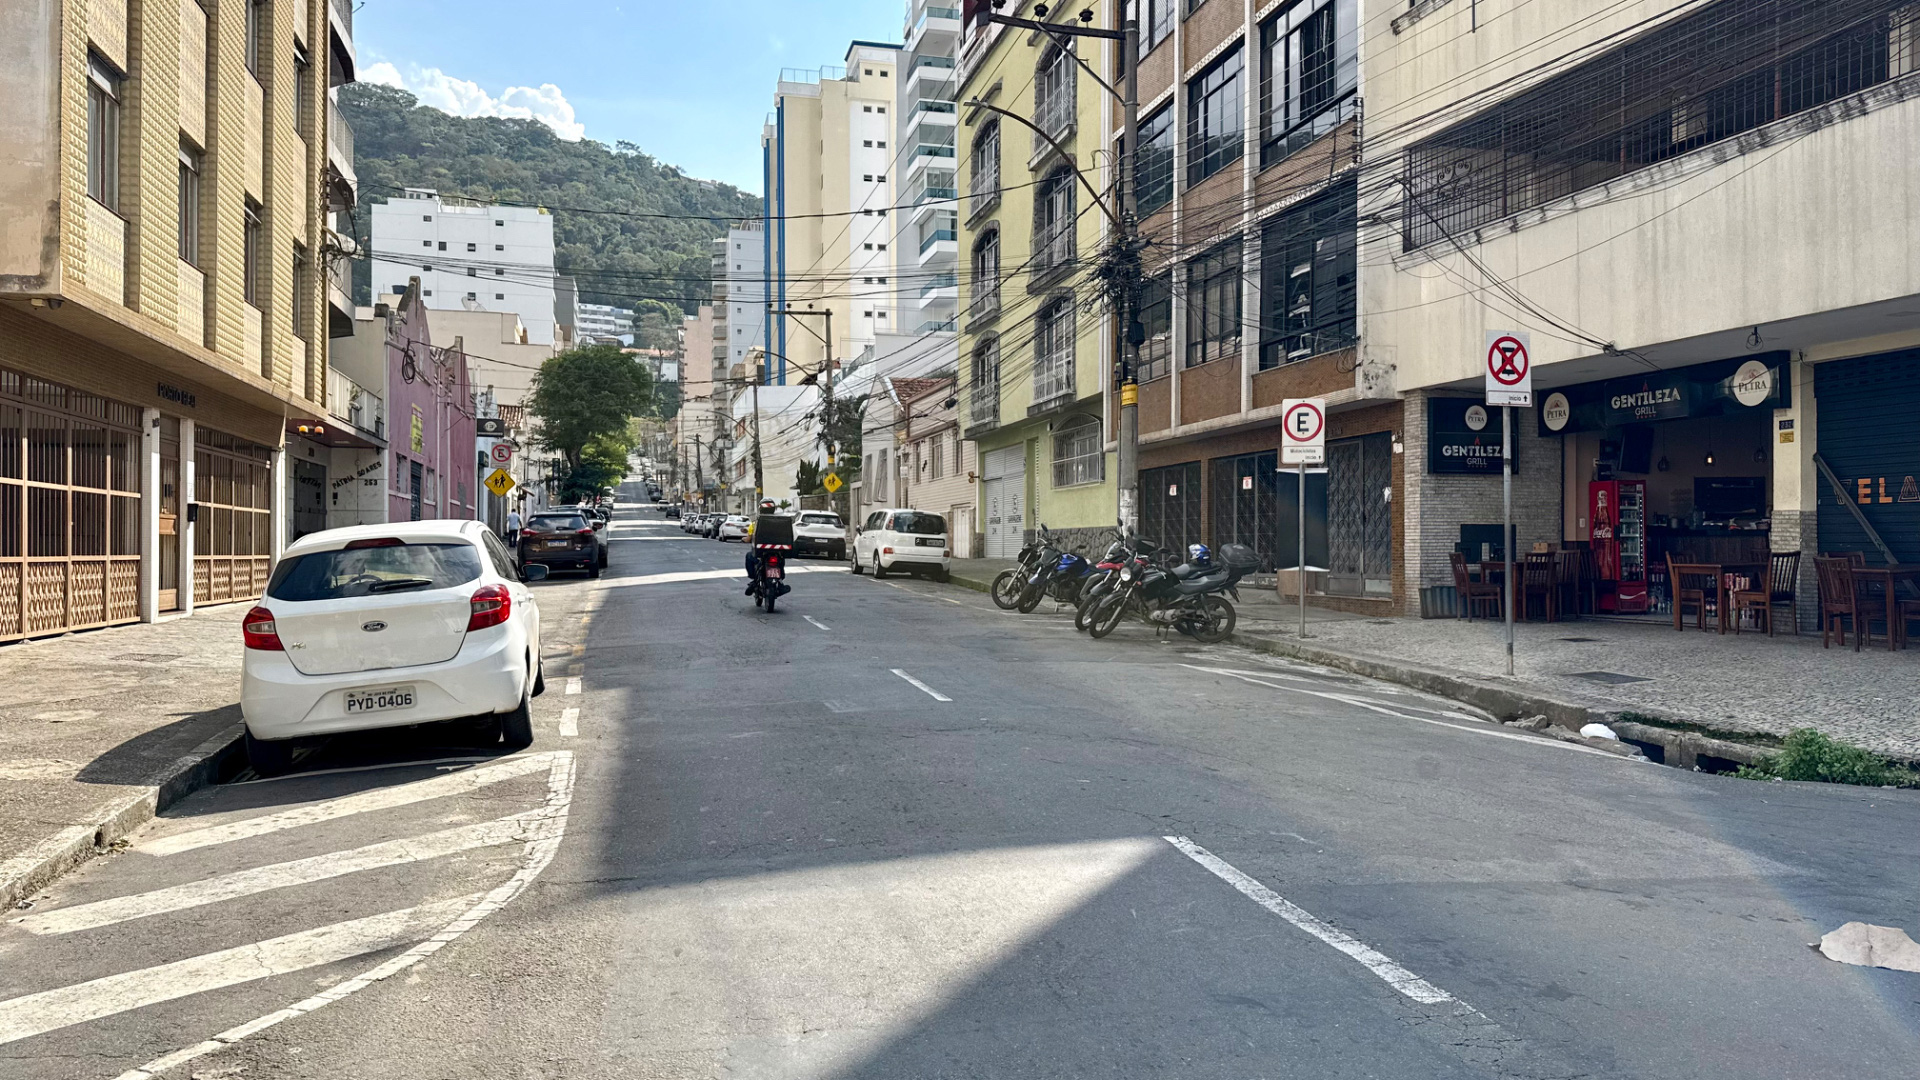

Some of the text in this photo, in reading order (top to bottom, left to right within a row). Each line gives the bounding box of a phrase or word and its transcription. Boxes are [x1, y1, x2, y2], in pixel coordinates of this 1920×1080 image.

[1738, 379, 1768, 394] PETRA
[1611, 387, 1681, 410] GENTILEZA
[1546, 409, 1567, 419] PETRA
[1634, 406, 1657, 417] GRILL
[1296, 412, 1310, 432] E
[1467, 415, 1485, 423] PETRA
[1442, 444, 1503, 458] GENTILEZ
[1466, 457, 1488, 465] GRILL
[357, 461, 382, 477] SOARES
